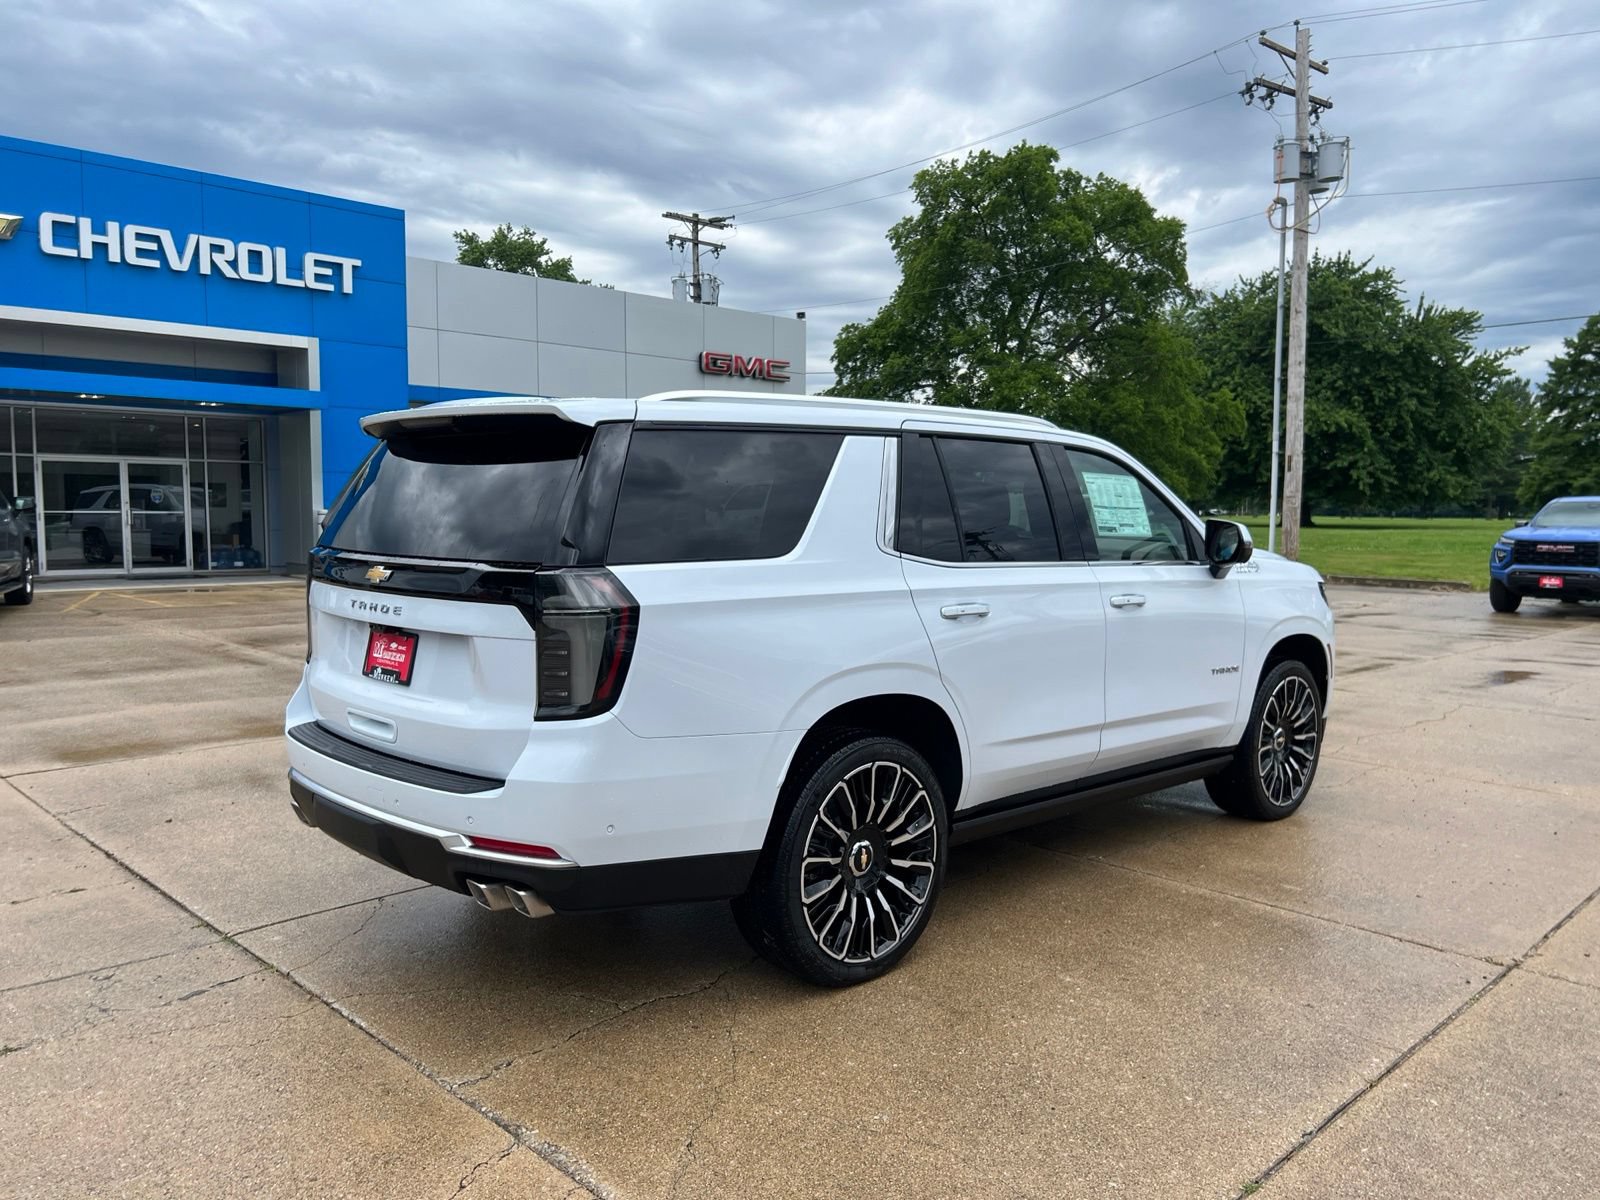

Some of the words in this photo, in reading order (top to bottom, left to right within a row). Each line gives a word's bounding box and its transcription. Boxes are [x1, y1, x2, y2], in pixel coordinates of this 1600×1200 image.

[39, 211, 362, 295] CHEVROLET
[700, 351, 790, 382] GMC
[350, 599, 403, 616] TAHOE
